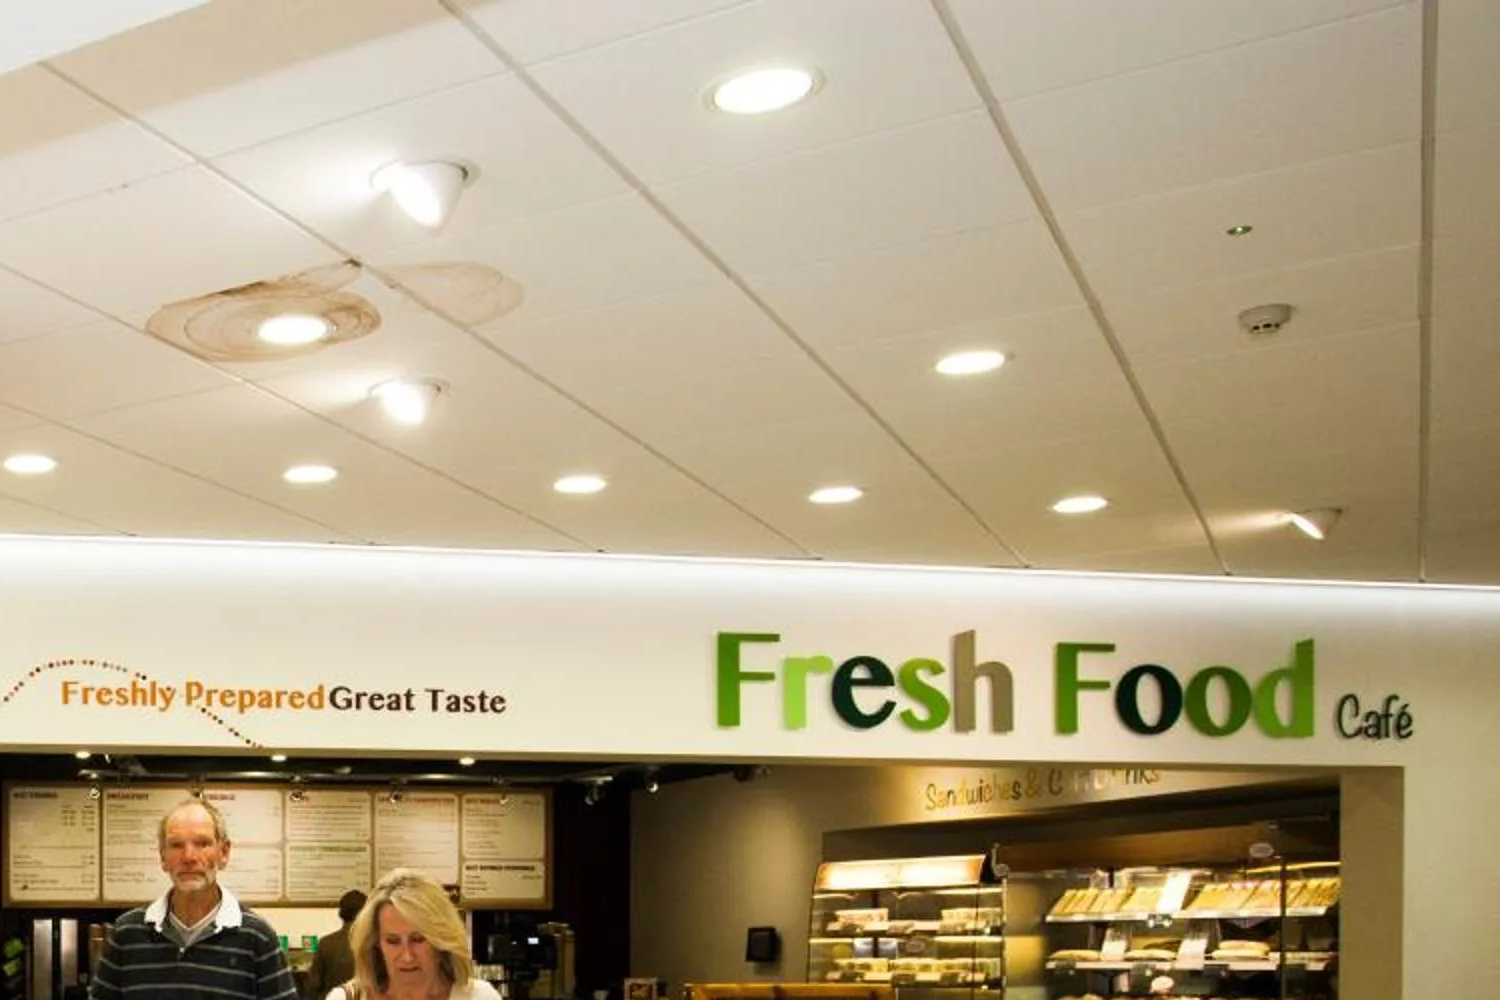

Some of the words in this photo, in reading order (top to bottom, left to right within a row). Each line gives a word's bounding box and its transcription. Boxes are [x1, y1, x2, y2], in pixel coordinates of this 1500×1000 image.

[61, 680, 177, 712] Freshly
[185, 681, 325, 714] Prepared
[329, 685, 416, 711] Great
[426, 687, 507, 713] Taste
[716, 630, 1014, 734] Fresh
[1054, 638, 1315, 738] Food
[1335, 693, 1414, 741] Café
[926, 772, 1021, 811] Sandwiches
